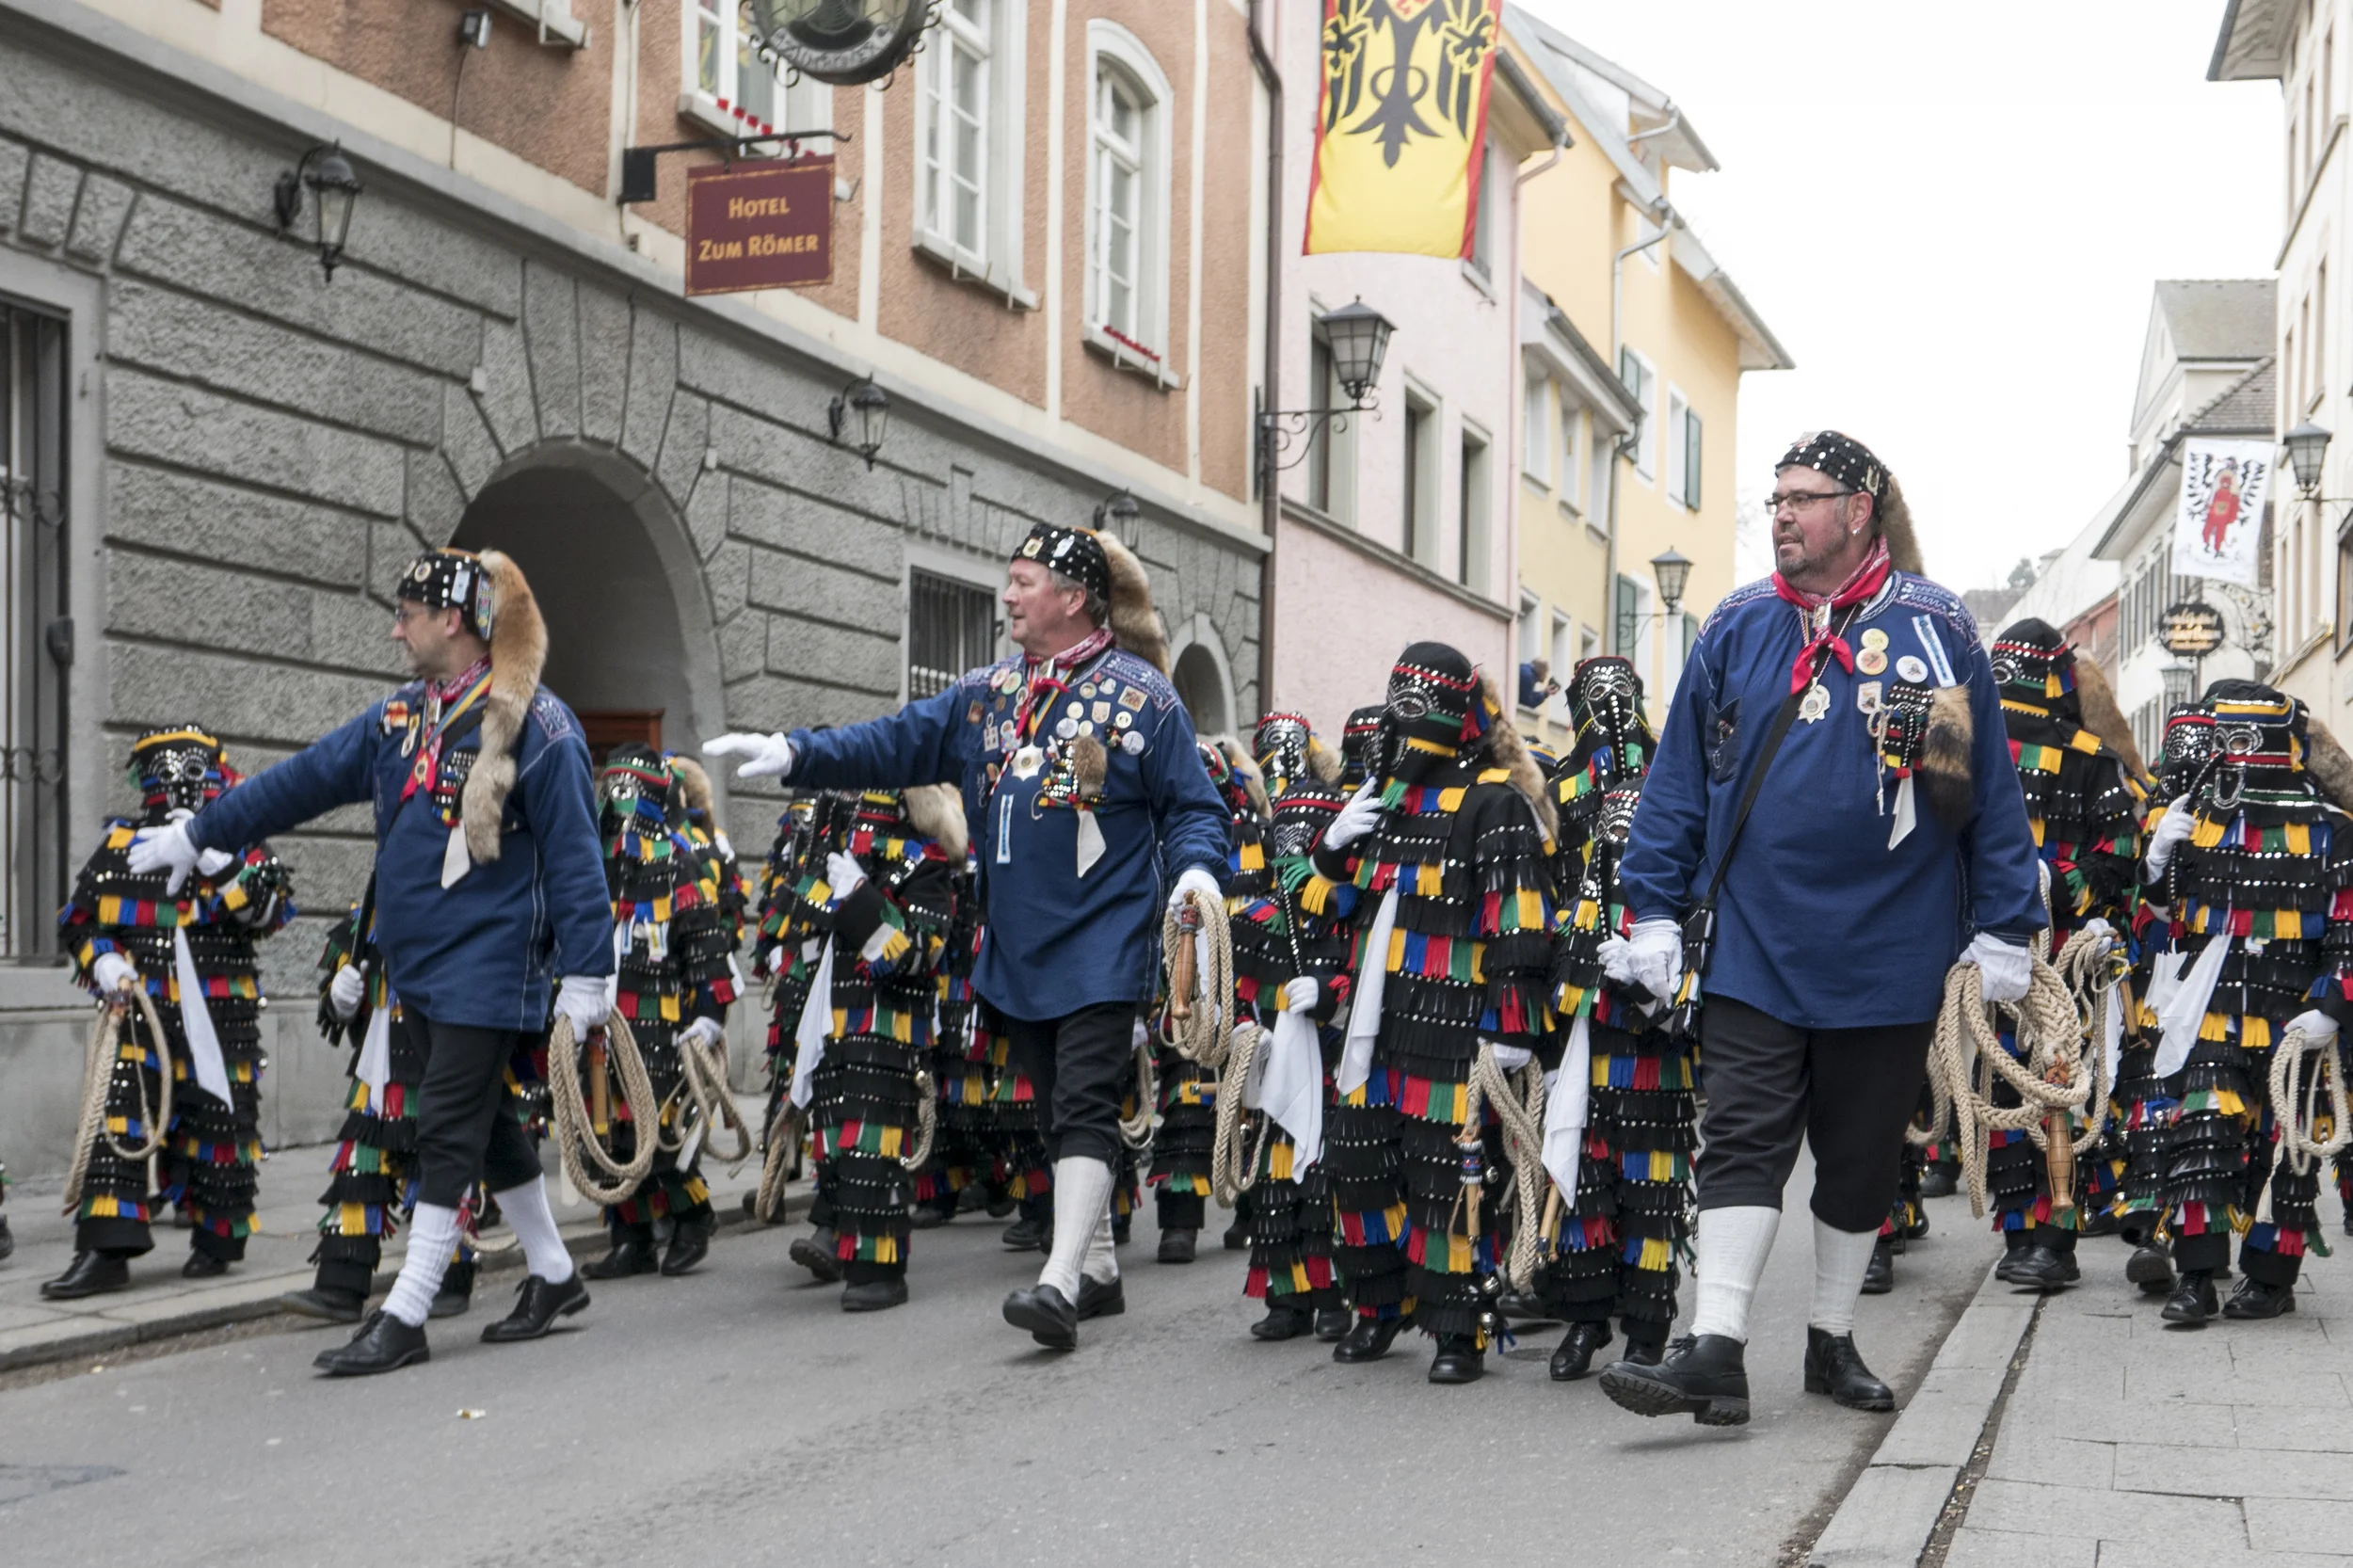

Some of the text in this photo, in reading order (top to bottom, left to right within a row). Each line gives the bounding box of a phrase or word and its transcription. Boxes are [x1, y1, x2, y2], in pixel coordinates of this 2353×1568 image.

[728, 196, 791, 219] HOTEL
[698, 233, 819, 262] ZUM RÖMER
